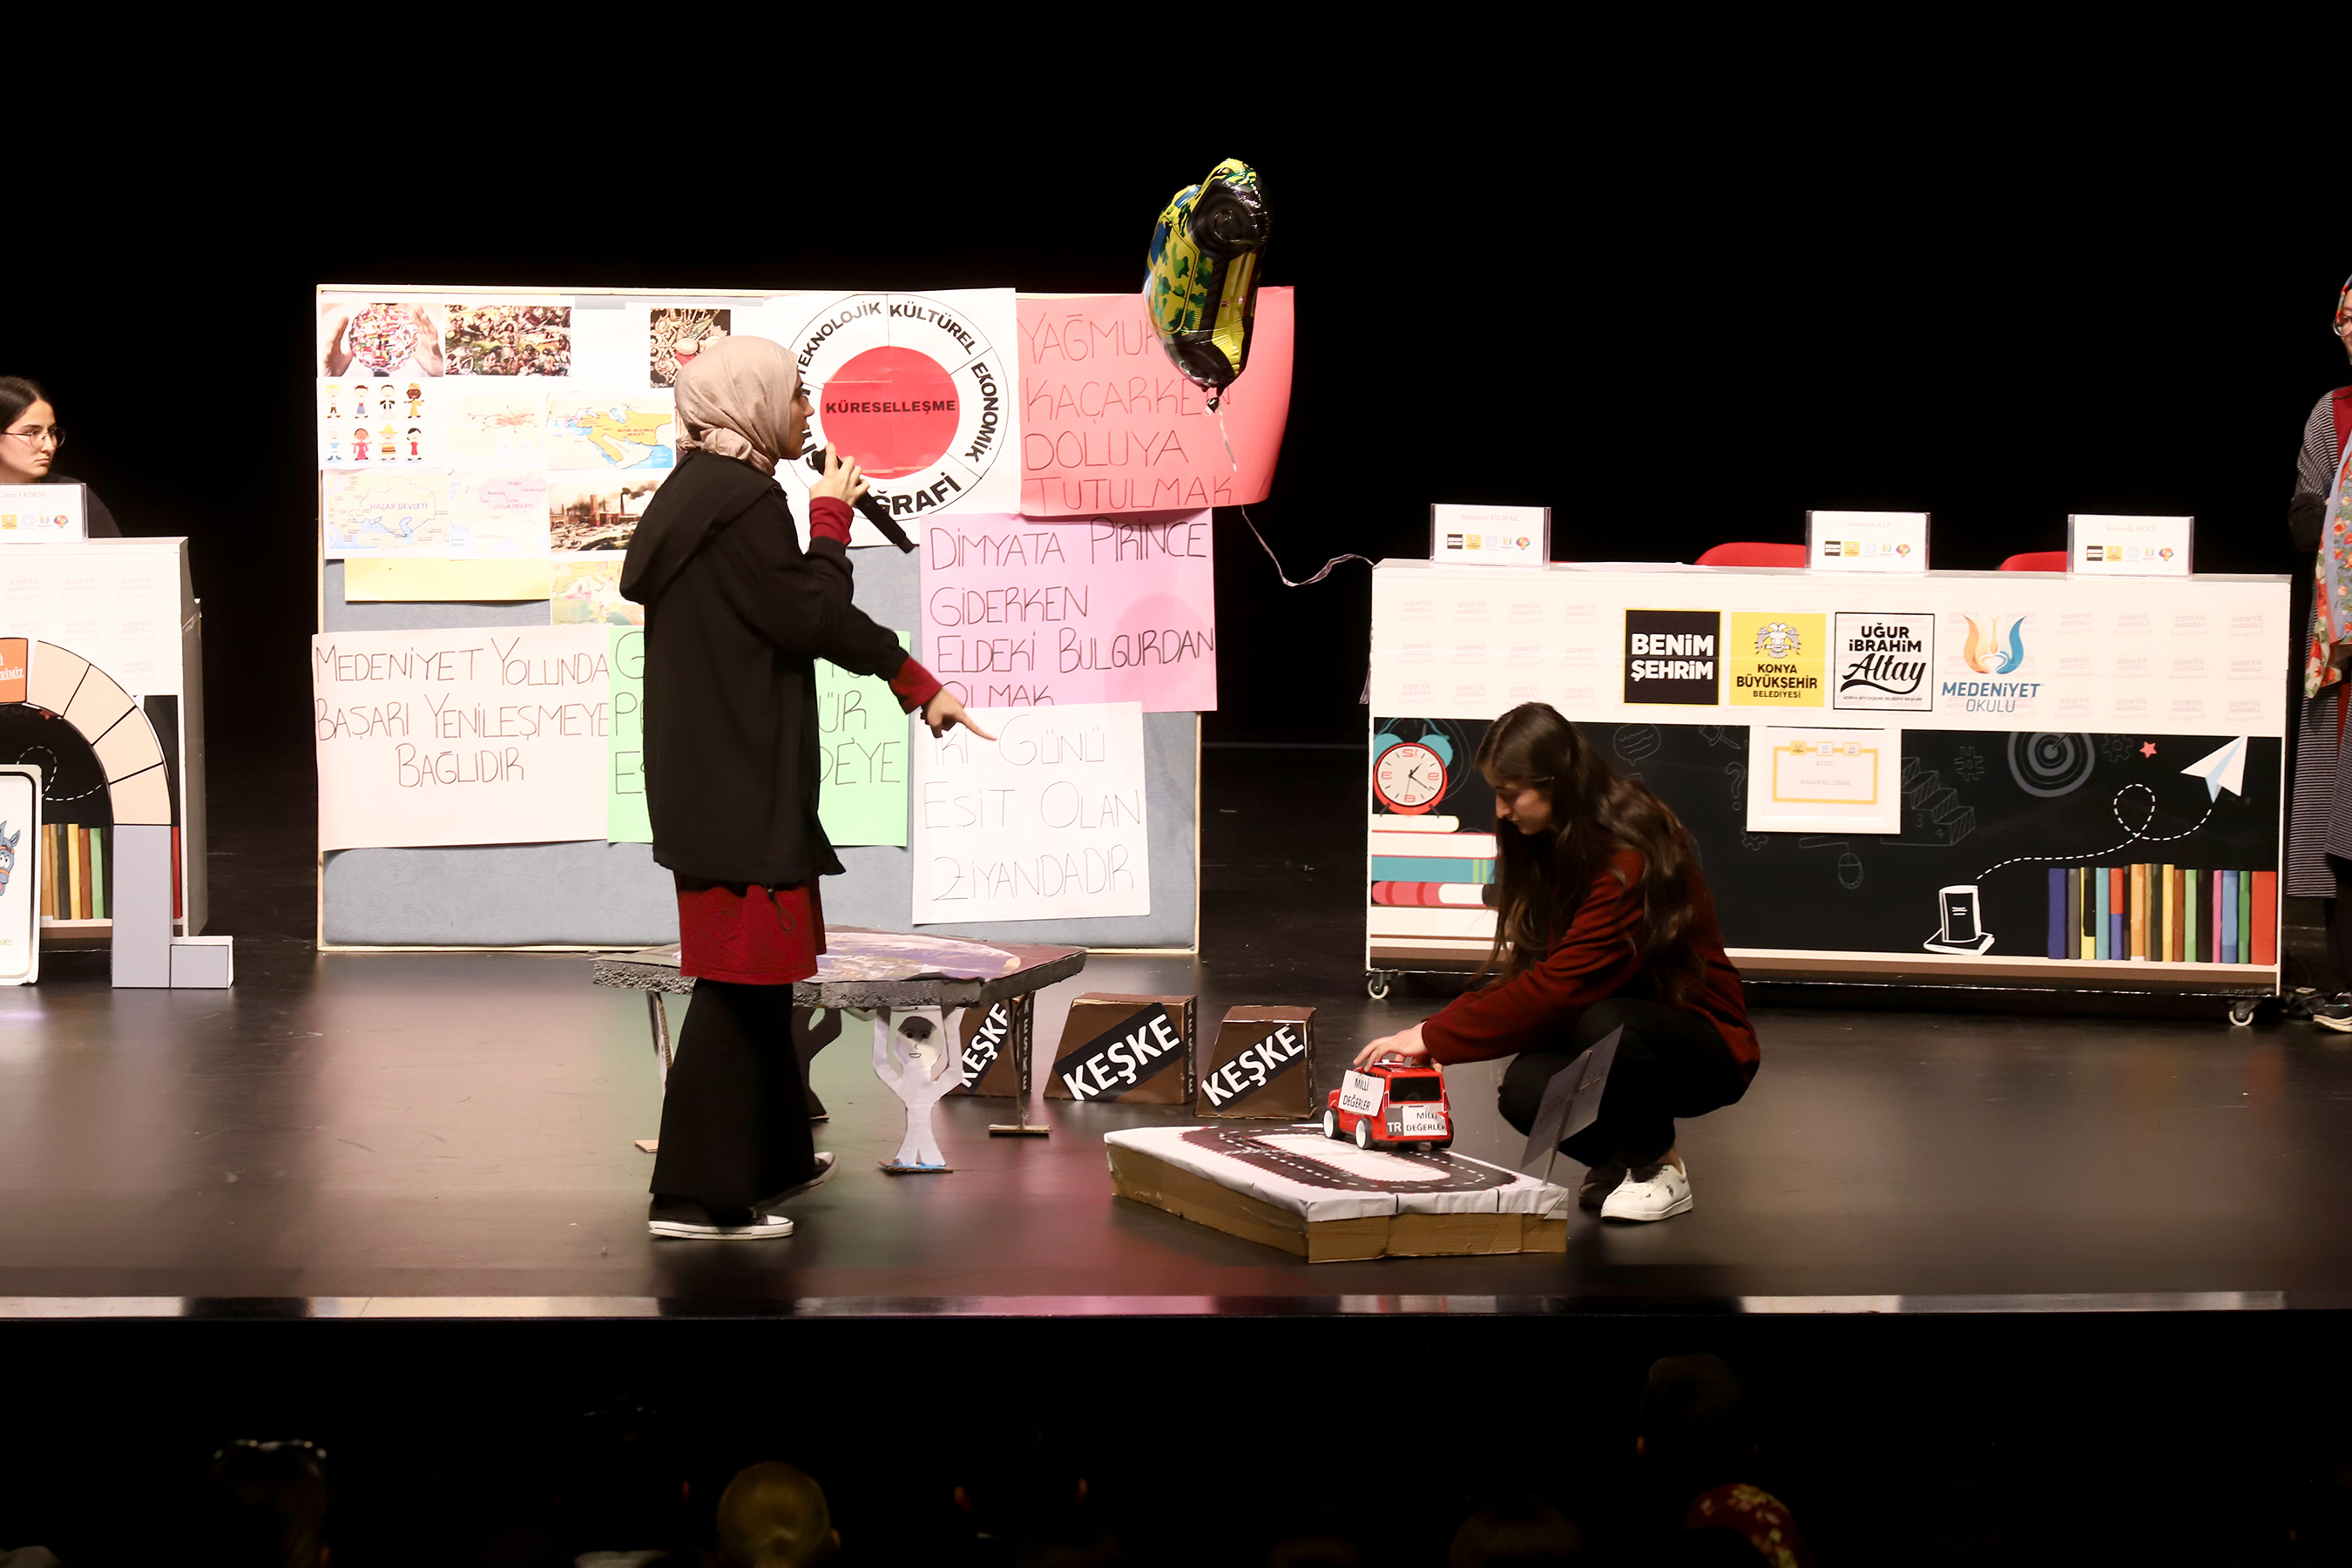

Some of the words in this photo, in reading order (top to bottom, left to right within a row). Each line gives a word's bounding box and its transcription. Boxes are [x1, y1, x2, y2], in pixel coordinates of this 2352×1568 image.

[889, 301, 977, 356] KÜLTÜREL
[826, 398, 956, 416] KÜRESELLEŞME
[964, 361, 999, 463] EKONOMİK
[1024, 429, 1189, 470] DOLUYA
[874, 474, 962, 516] ĞRAFİ
[1024, 476, 1232, 515] TUTULMAK
[929, 527, 1065, 571] DİMYATA
[1090, 517, 1207, 564] PİRİNCE
[929, 585, 1088, 626] GİDERKEN
[937, 631, 1037, 673] ELDEKİ
[1059, 626, 1214, 673] BULGURDAN
[1861, 621, 1910, 639] UĞUR
[0, 667, 24, 680] RİMİZ
[315, 645, 483, 685] MEDENİYET
[490, 637, 610, 686] YOLUNDA
[1736, 673, 1818, 690] BÜYÜKŞEHİR
[1757, 664, 1798, 673] KONYA
[1840, 652, 1927, 690] Altay
[819, 690, 867, 733] ÜR
[1753, 689, 1801, 698] BELEDİYESİ
[1965, 699, 2017, 713] OKULU
[315, 698, 409, 741] BAŞARI
[424, 693, 610, 739] YENİLEŞMEYE
[998, 714, 1105, 766] GÜNÜ
[395, 742, 524, 788] BAĞLIDIR
[1041, 781, 1141, 828] OLAN
[1062, 1013, 1180, 1101] KEŞKE
[1201, 1025, 1304, 1106] KEŞKE
[1343, 1095, 1371, 1112] DEĞERLER
[1355, 1078, 1369, 1092] MİLLİ
[1387, 1122, 1402, 1132] TR
